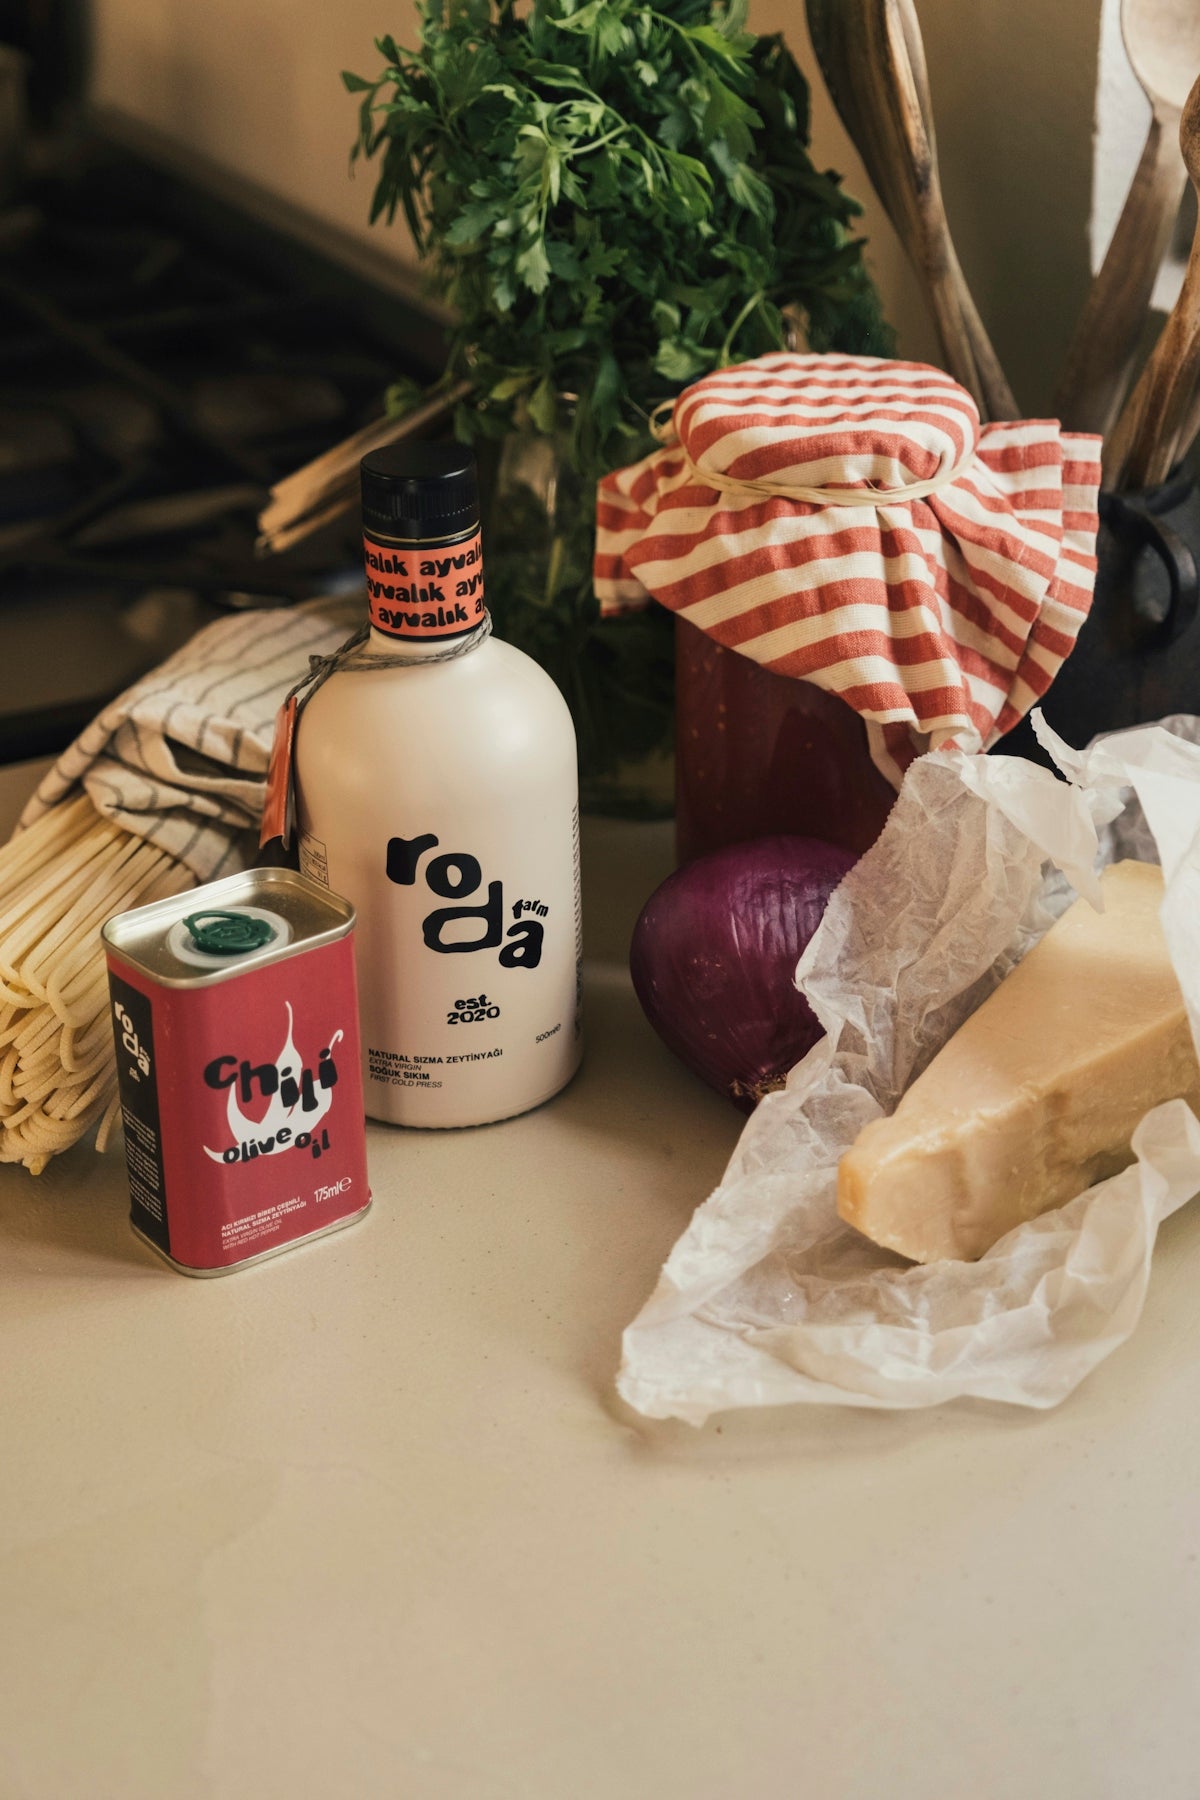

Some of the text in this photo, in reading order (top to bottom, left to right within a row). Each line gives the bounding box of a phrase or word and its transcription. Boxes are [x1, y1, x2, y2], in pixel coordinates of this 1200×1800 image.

[378, 603, 469, 629] ayvalık
[386, 833, 545, 969] roda
[511, 899, 549, 919] farm
[454, 994, 492, 1010] est.
[447, 1006, 501, 1025] 2020
[368, 1048, 411, 1063] NATURAL
[413, 1055, 444, 1064] SIZMA
[369, 1057, 422, 1071] EXTRA VIRGIN
[369, 1065, 430, 1080] SOĞUK SIKIM
[370, 1073, 443, 1088] FIRST COLD PRESS
[223, 1127, 331, 1164] olive oil
[221, 1223, 251, 1238] NATURAL
[251, 1215, 271, 1227] SIZMA
